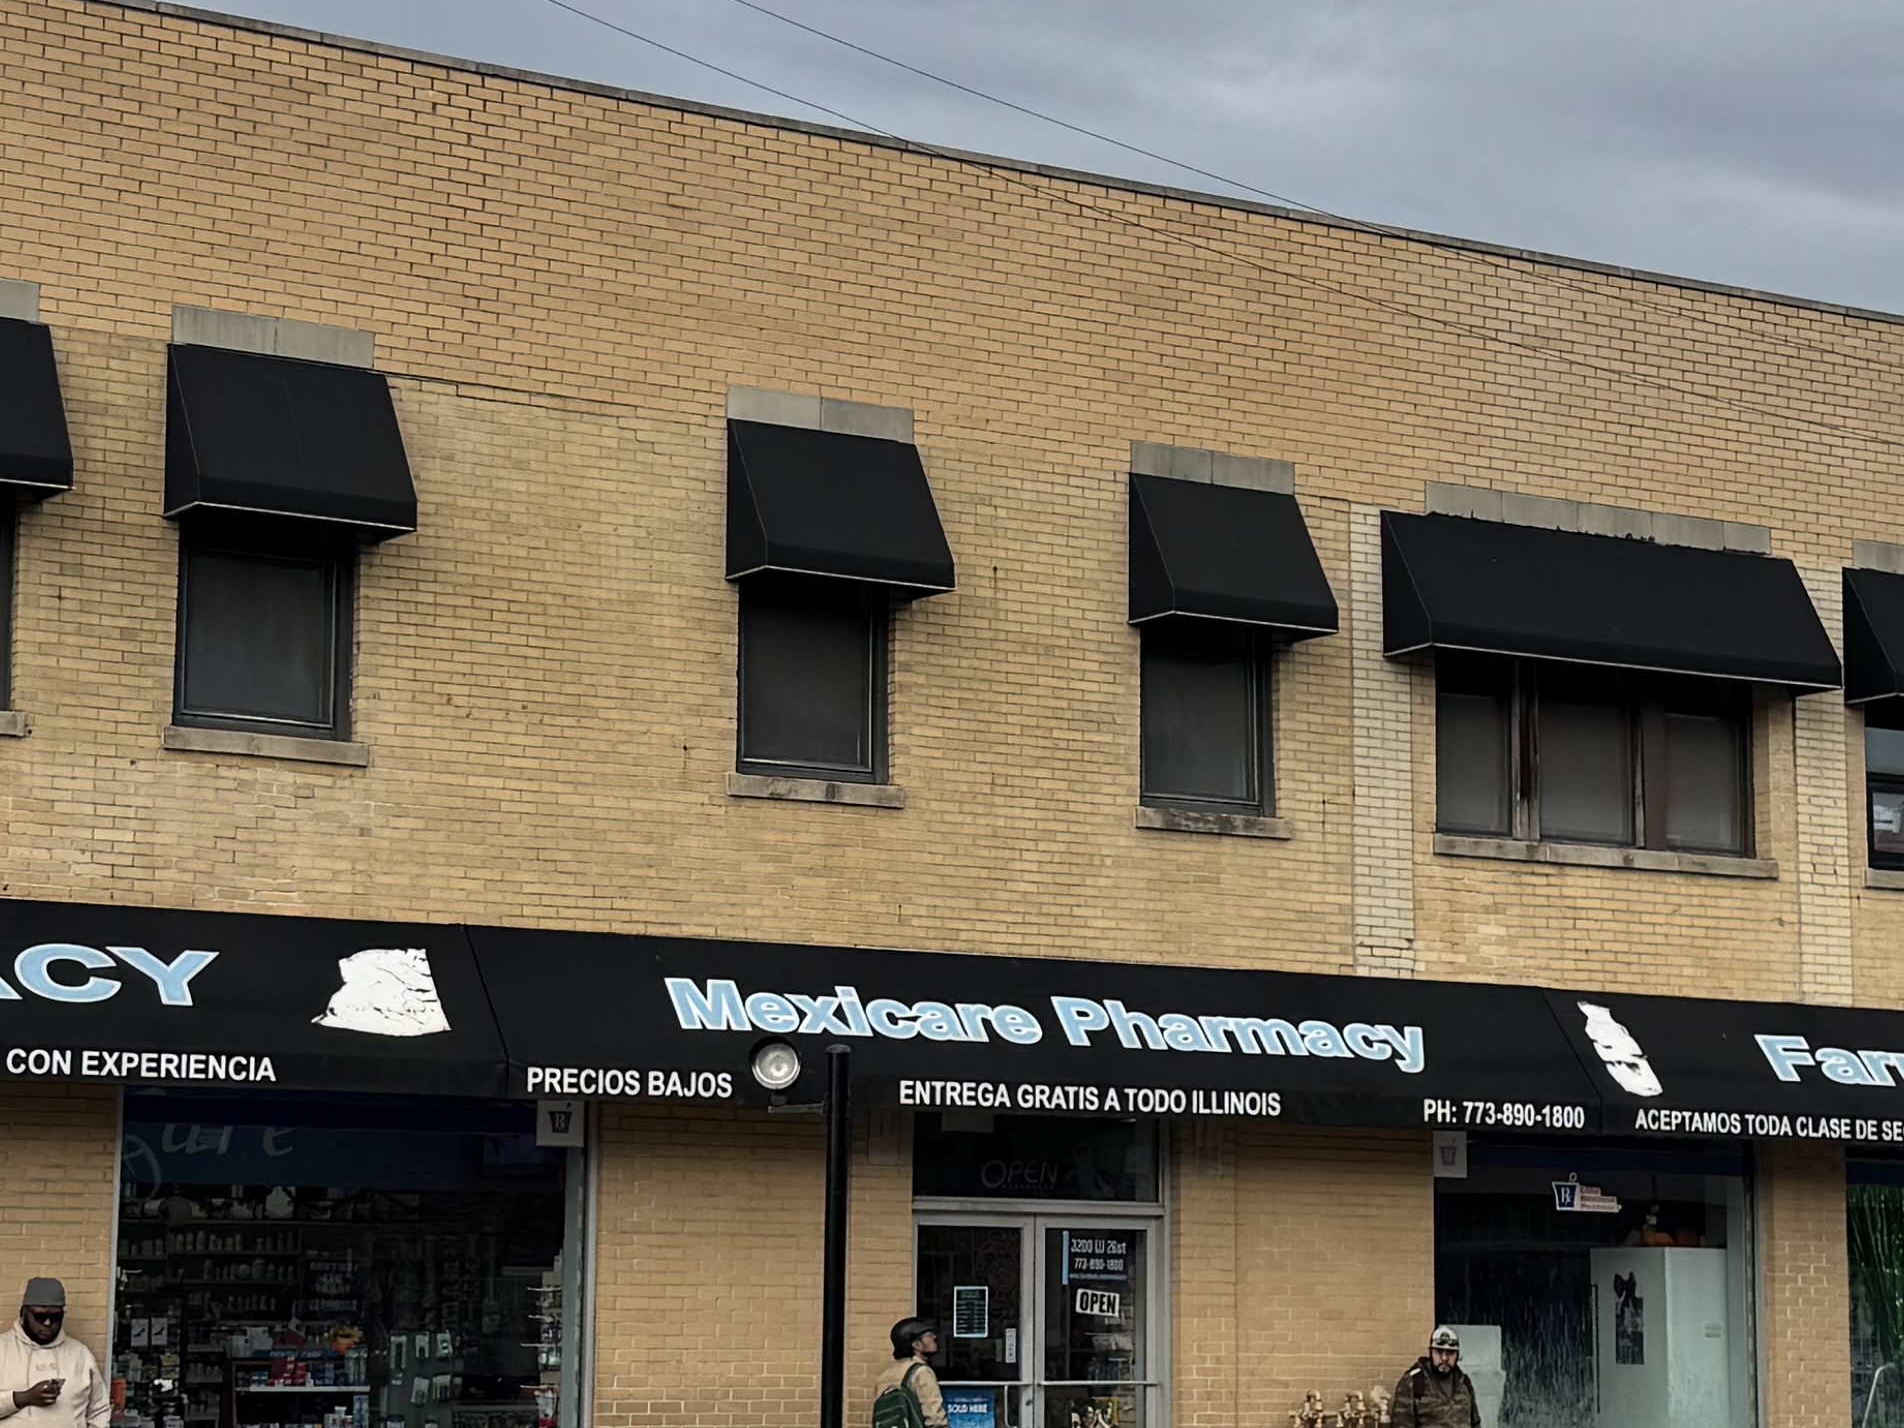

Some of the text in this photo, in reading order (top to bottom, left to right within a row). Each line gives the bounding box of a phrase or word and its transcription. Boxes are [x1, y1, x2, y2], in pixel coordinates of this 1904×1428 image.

[664, 977, 1425, 1073] Mexicare Pharmacy
[6, 1048, 71, 1074] CON
[82, 1050, 276, 1082] EXPERIENCIA
[527, 1066, 733, 1098] PRECIOS BAJOS
[900, 1080, 1283, 1116] ENTREGA GRATIS A TODO ILLINOIS
[1423, 1099, 1585, 1129] PH: 773-890-1800
[1635, 1109, 1741, 1134] ACEPTAMOS
[1745, 1113, 1792, 1136] TODA
[1796, 1116, 1852, 1139] CLASE
[1856, 1119, 1878, 1140] DE
[981, 1159, 1059, 1189] OPEN
[1080, 1291, 1116, 1315] OPEN
